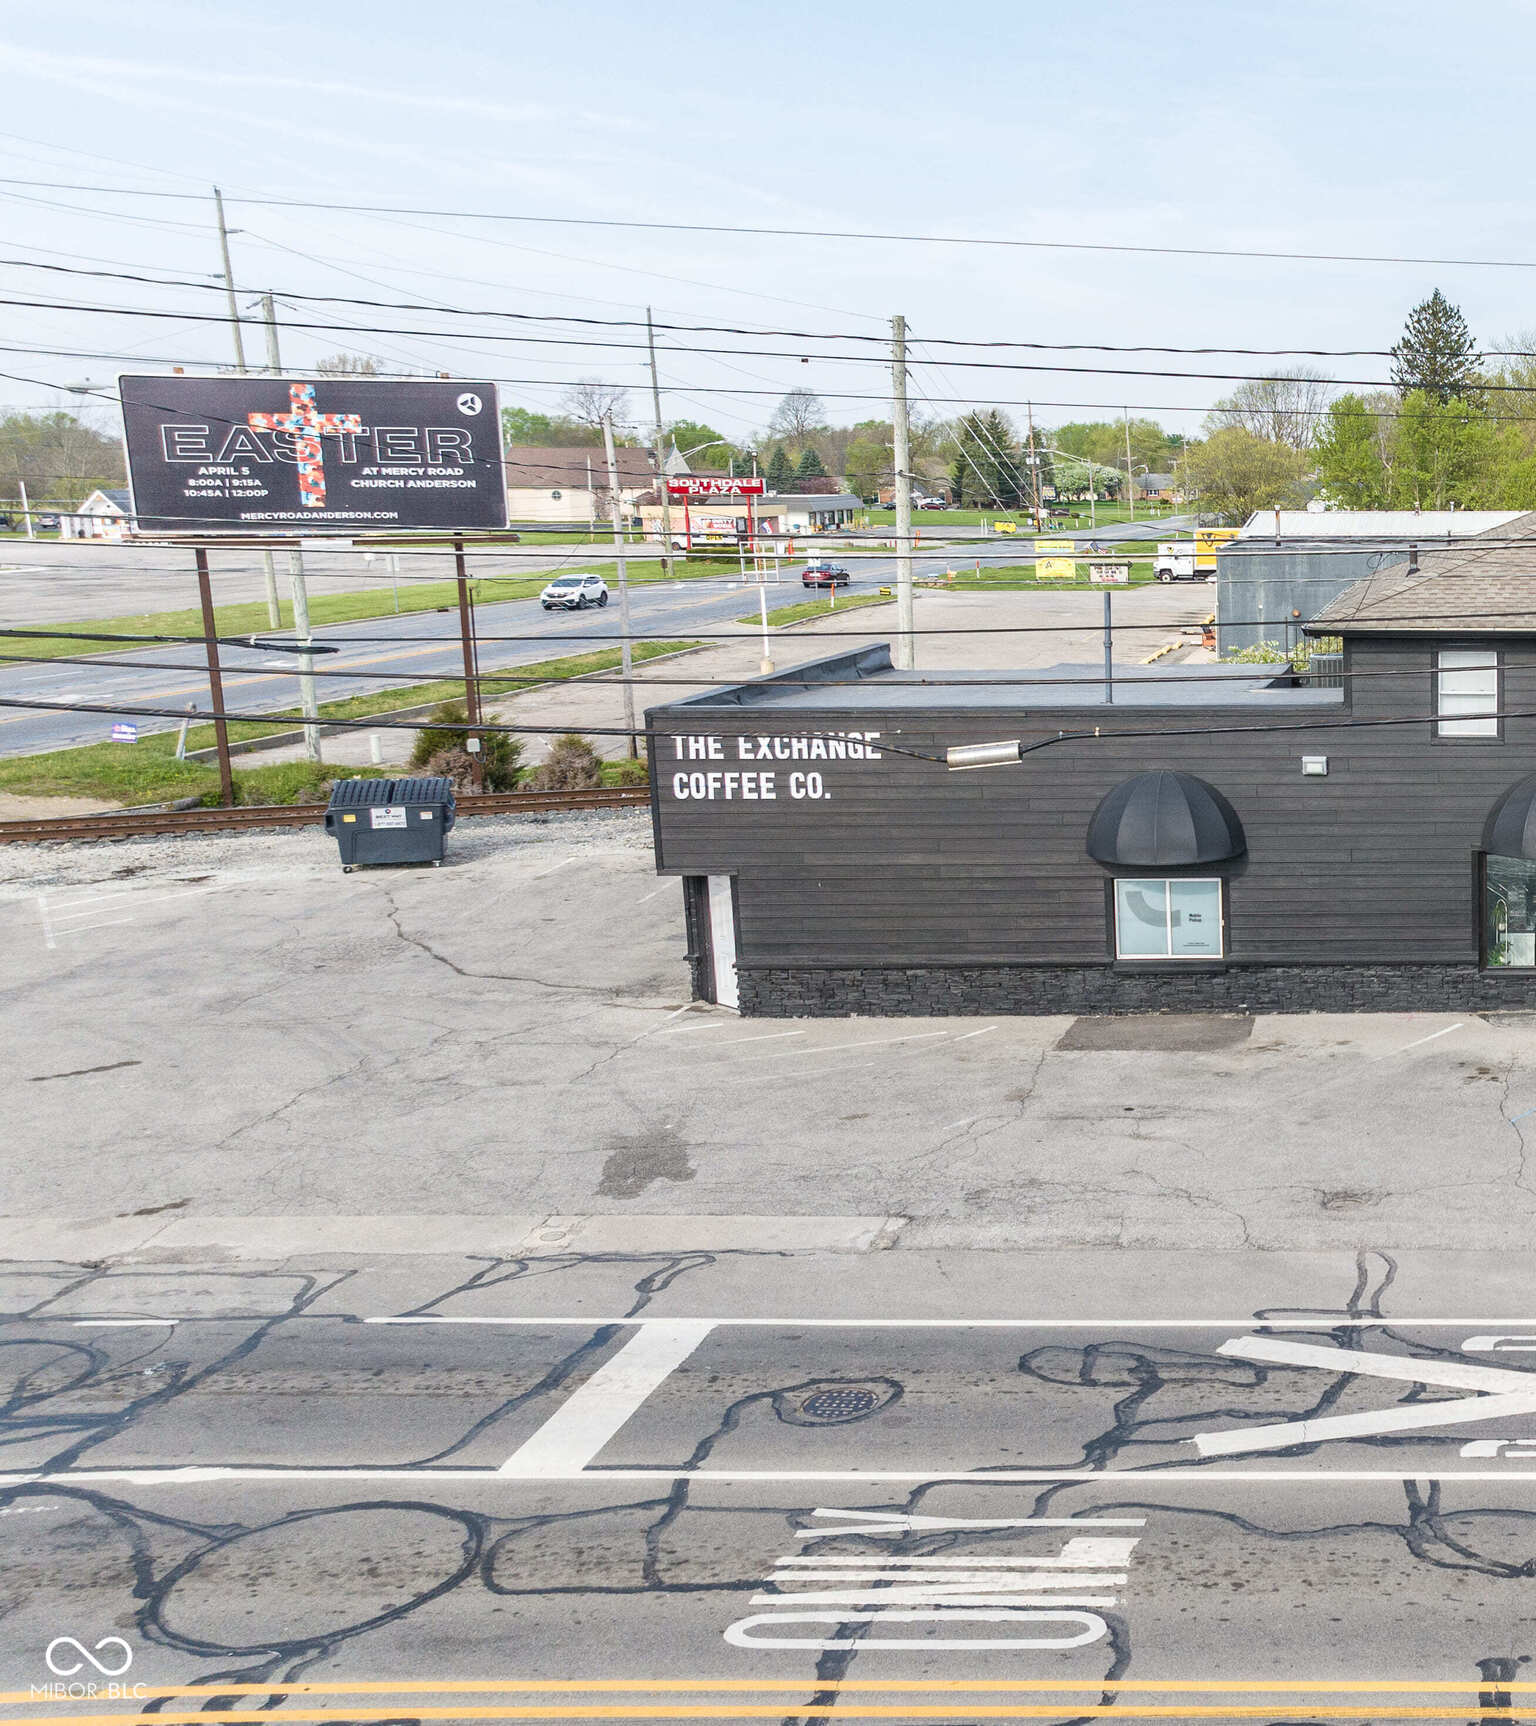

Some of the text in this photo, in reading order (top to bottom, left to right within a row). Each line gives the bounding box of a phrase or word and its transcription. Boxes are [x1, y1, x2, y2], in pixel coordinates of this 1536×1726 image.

[161, 424, 474, 464] EASTER
[199, 467, 250, 475] APRIL 5
[362, 467, 464, 475] AT MERCY ROAD
[351, 480, 477, 488] CHURCH ANDERSON
[669, 479, 761, 487] SOUTHDALE
[688, 486, 742, 494] PLAZA
[240, 512, 399, 520] MERCYROADANDERSON.COM
[671, 733, 725, 760] THE
[738, 732, 882, 760] EXCHANGE
[673, 772, 832, 800] COFFEE CO.
[723, 1508, 1147, 1650] ONLY
